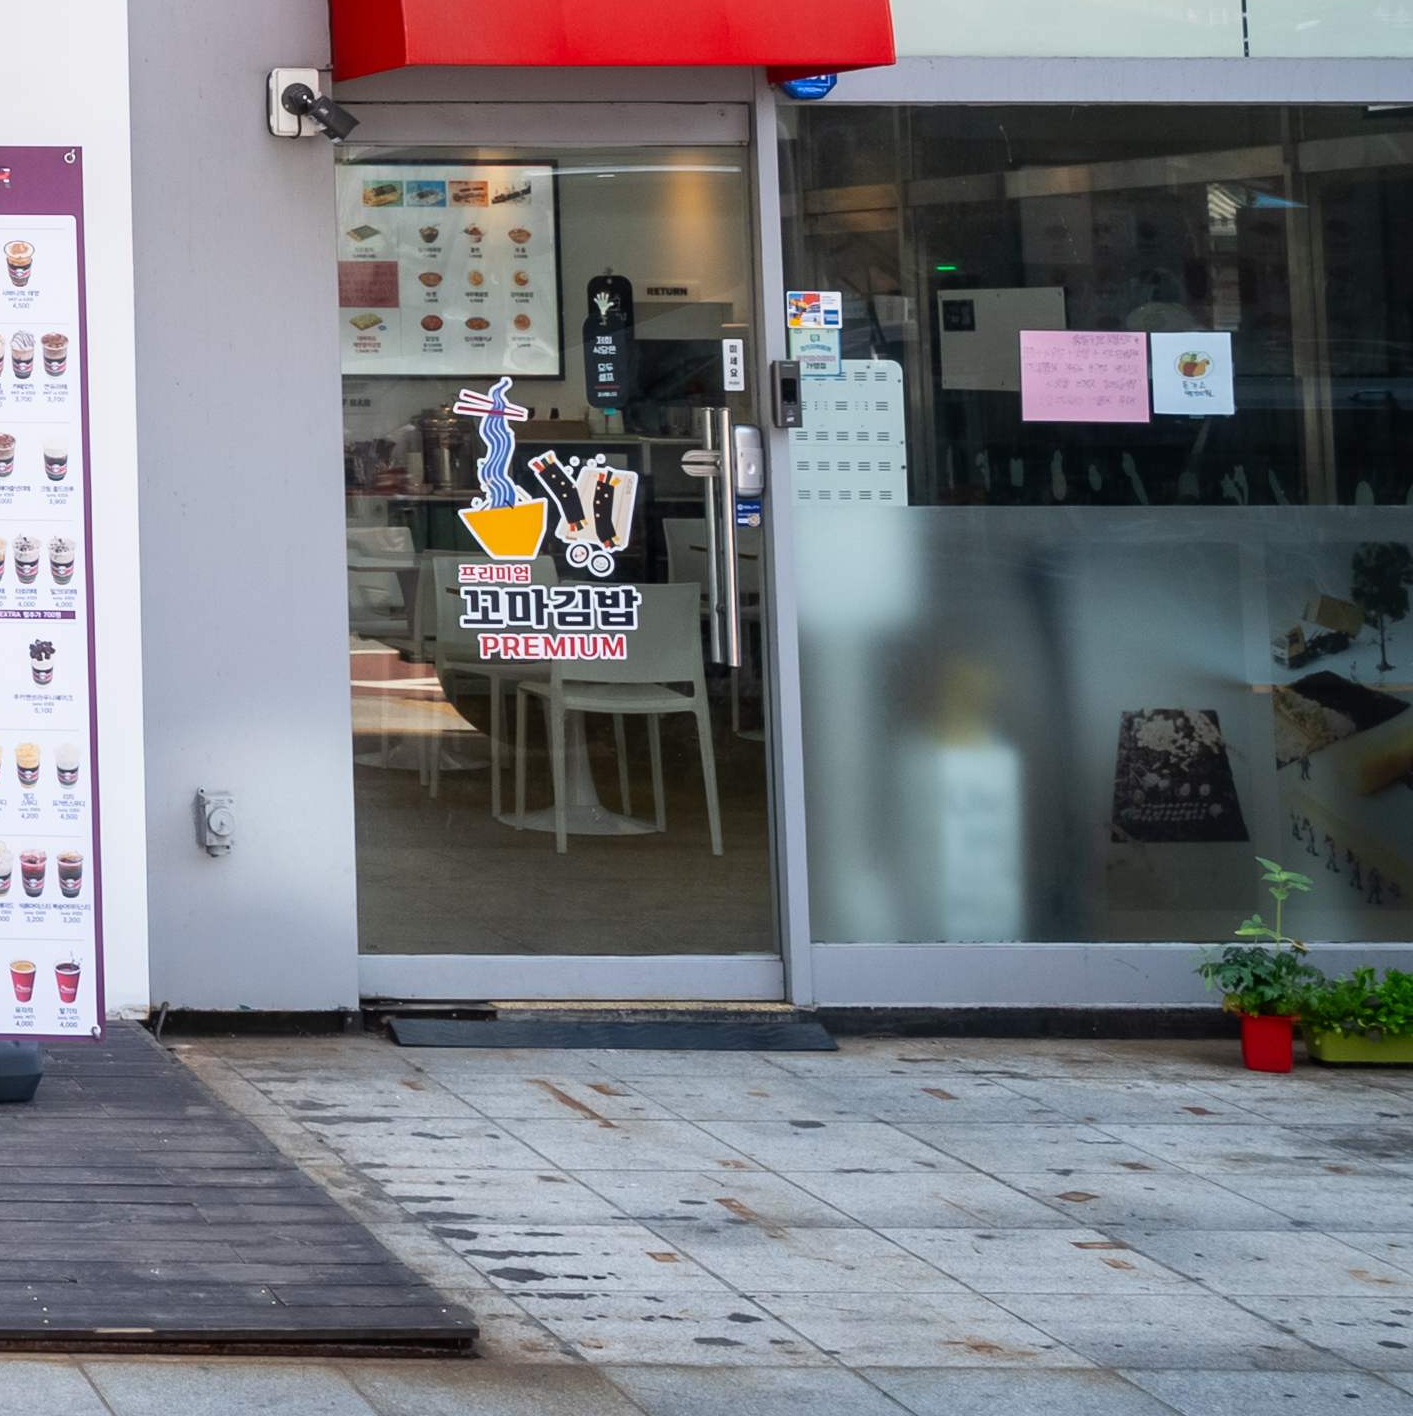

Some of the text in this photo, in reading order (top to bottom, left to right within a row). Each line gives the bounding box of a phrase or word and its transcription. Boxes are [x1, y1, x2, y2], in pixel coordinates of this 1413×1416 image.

[646, 286, 688, 296] RETURN
[459, 564, 531, 584] 프리미엄
[460, 585, 642, 630] 꼬마김밥
[478, 635, 628, 660] PREMIUM
